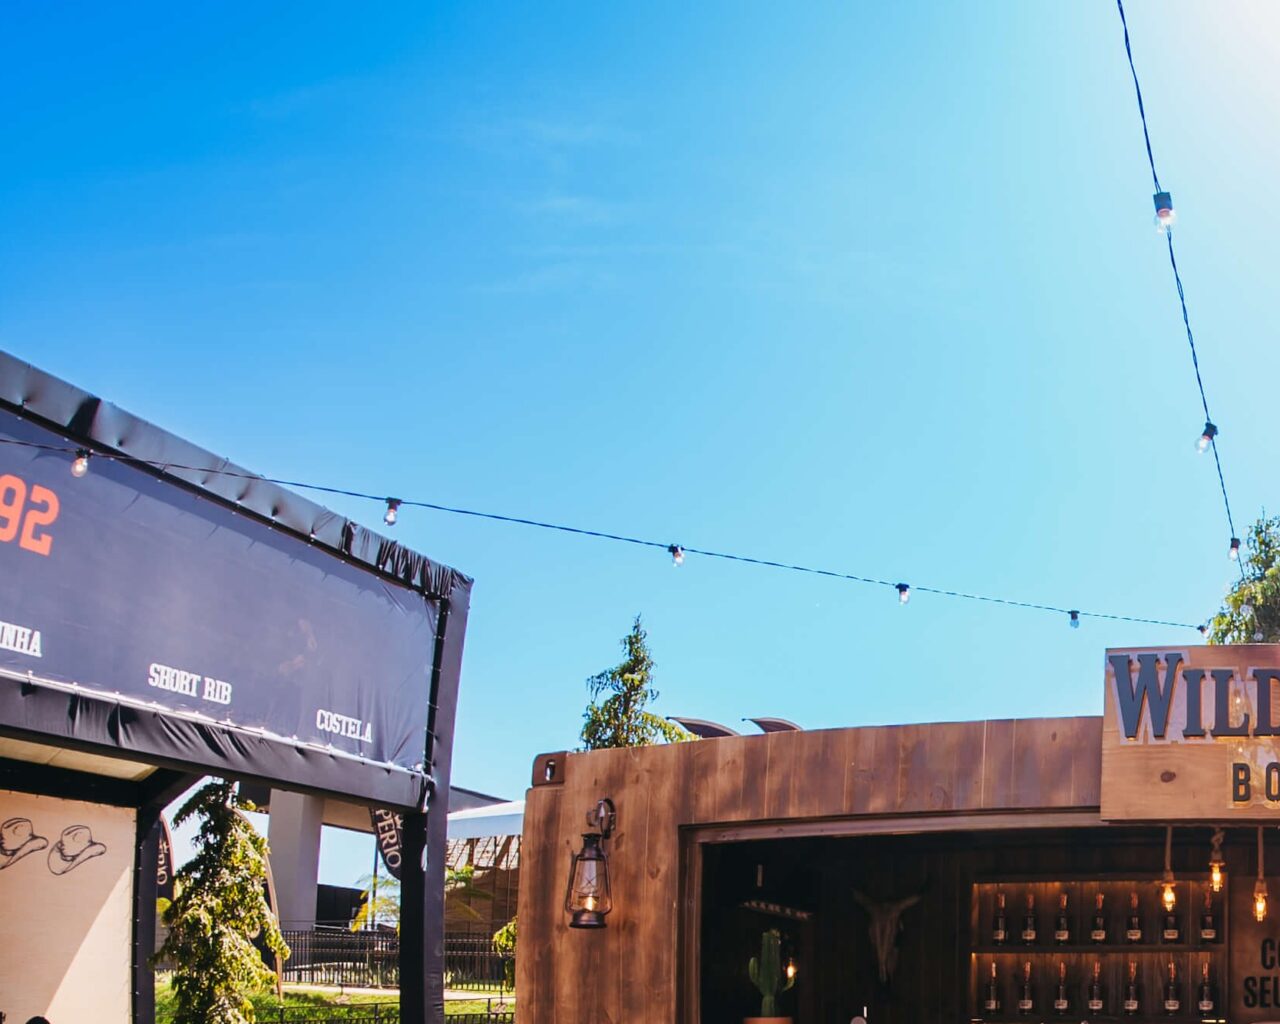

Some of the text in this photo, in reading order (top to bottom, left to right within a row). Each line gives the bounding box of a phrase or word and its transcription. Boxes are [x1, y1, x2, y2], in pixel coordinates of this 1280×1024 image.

[0, 474, 60, 556] 92
[148, 663, 232, 705] SHORT RIB
[316, 708, 373, 743] COSTELA
